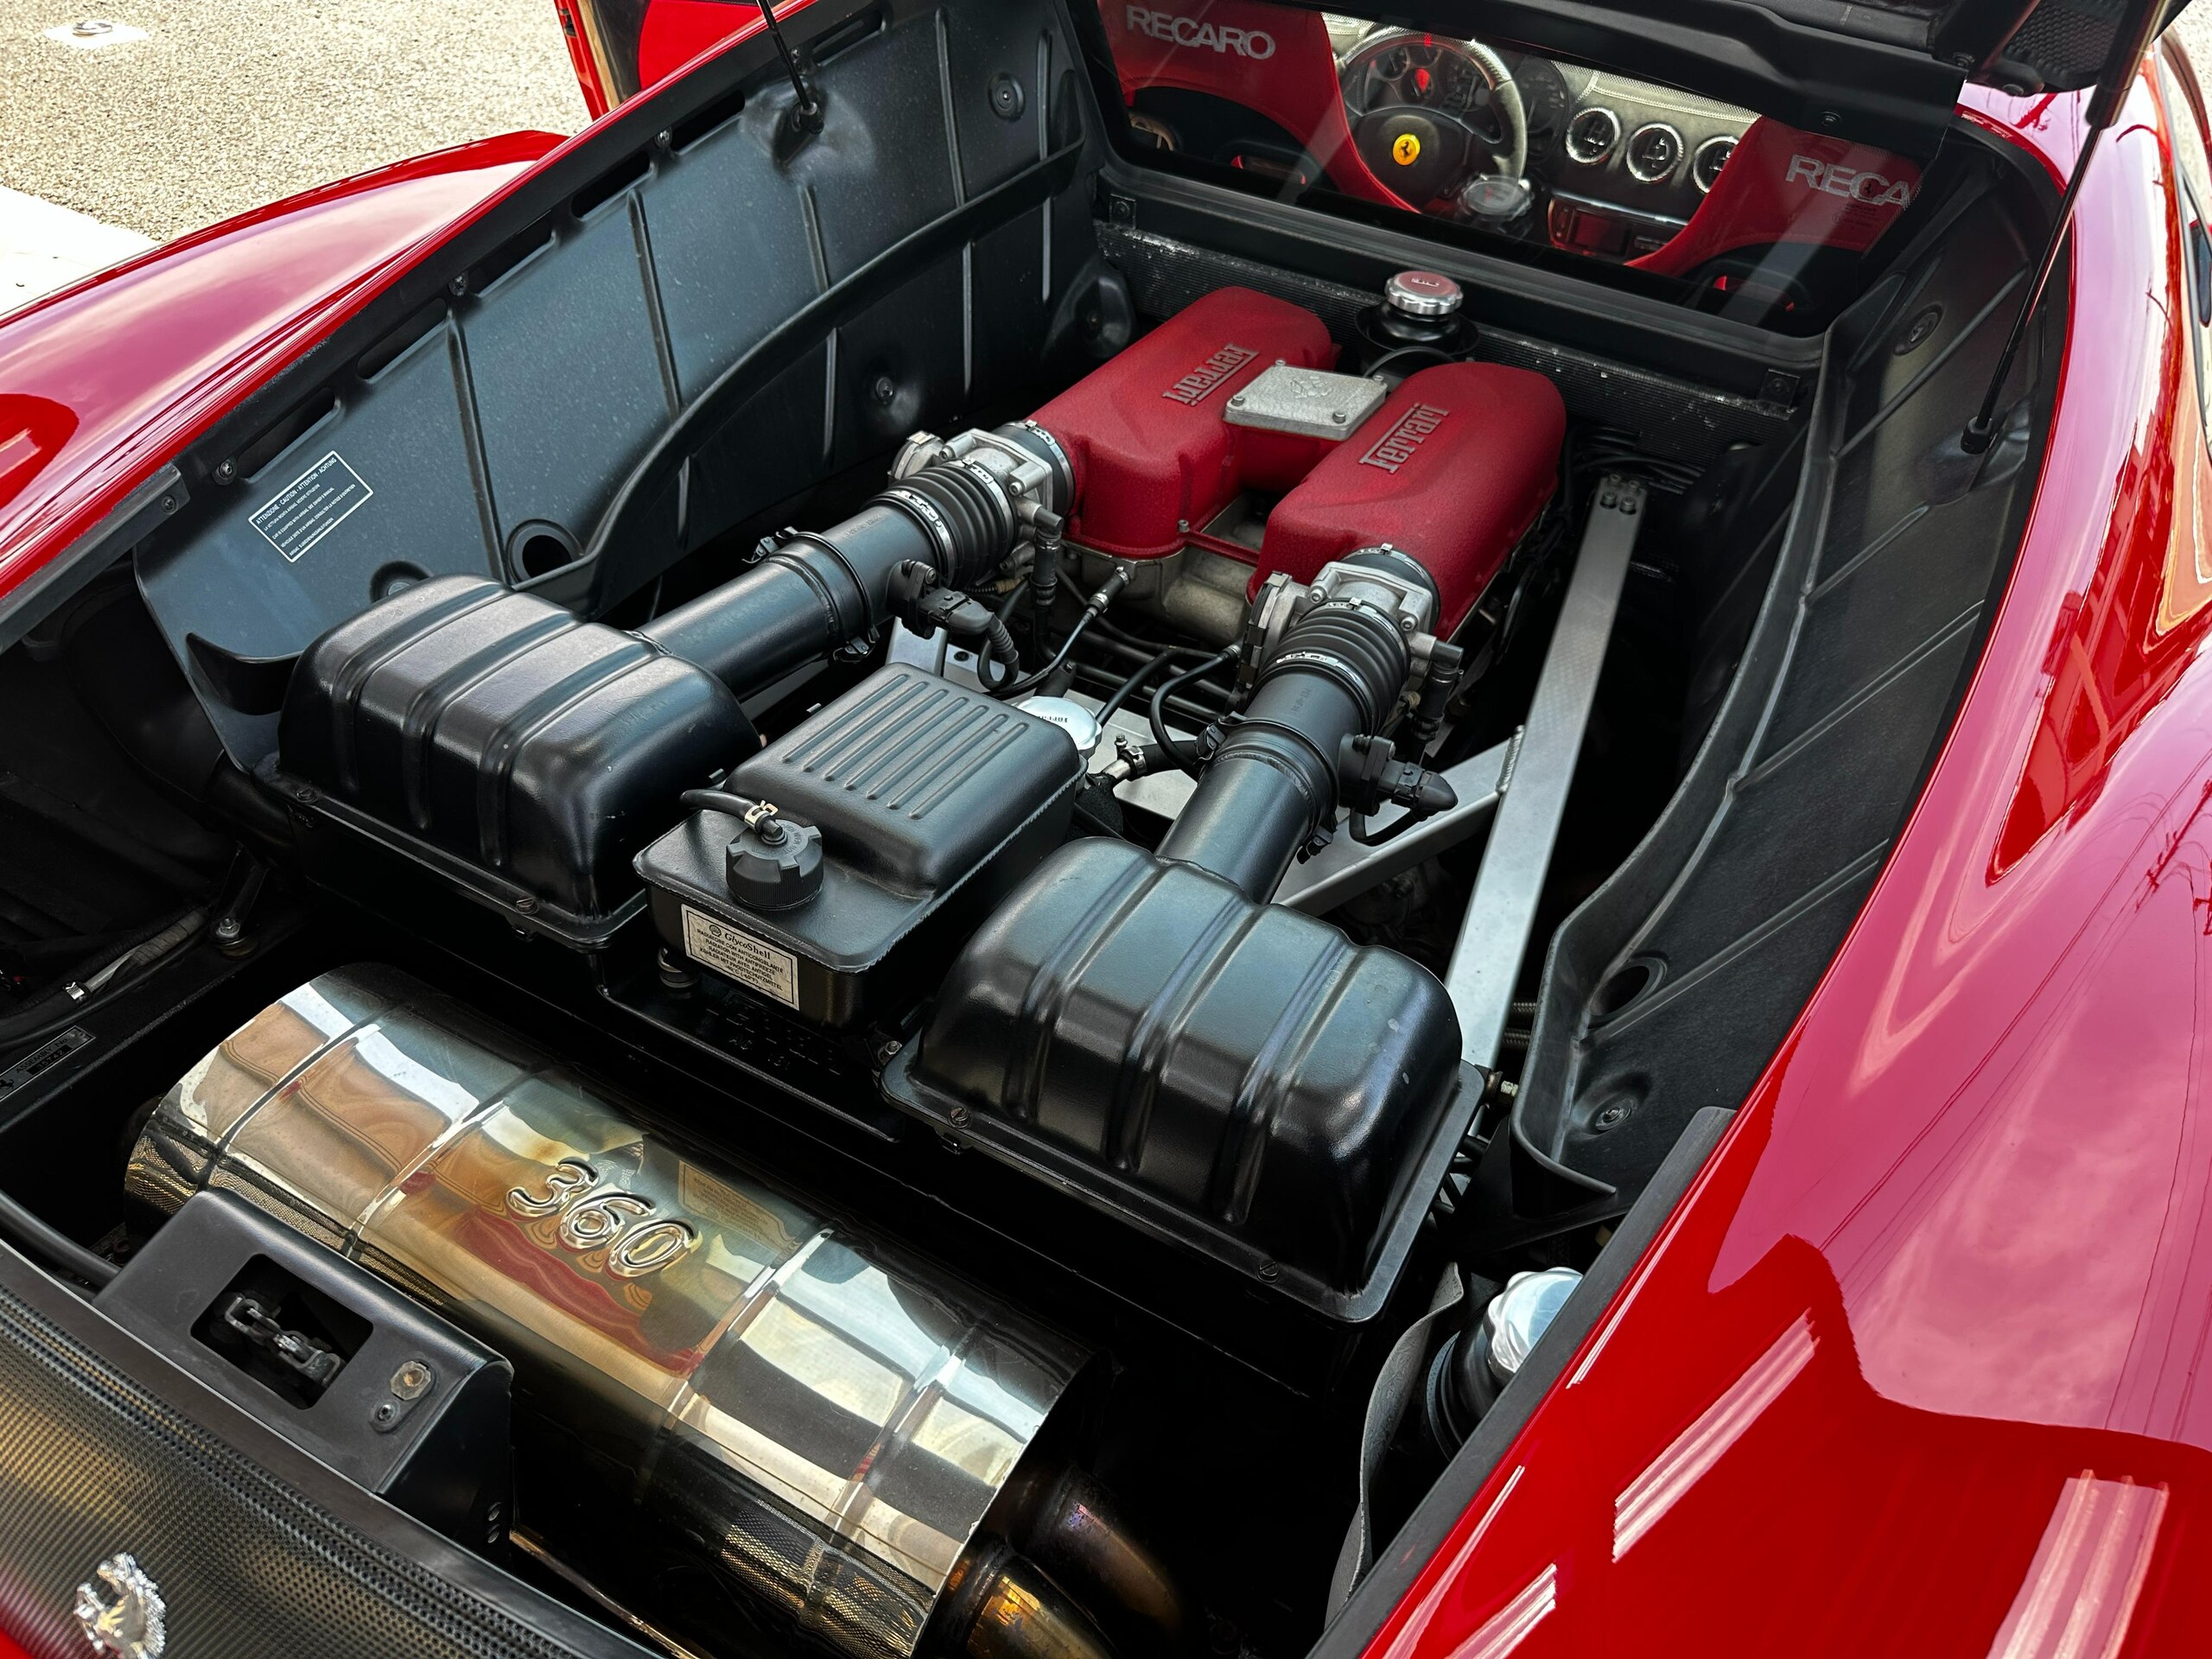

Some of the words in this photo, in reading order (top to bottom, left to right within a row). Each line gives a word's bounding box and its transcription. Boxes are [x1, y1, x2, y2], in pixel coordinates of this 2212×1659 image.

[1127, 4, 1275, 60] RECARO
[1162, 343, 1259, 406] Ferrari
[1358, 402, 1450, 474] Ferrari
[256, 504, 280, 524] ATTENZIONE
[279, 489, 297, 505] CAUTION
[297, 473, 319, 491] ATTENTION
[318, 457, 337, 474] ACHTUNG
[697, 928, 724, 945] RADIATORE
[726, 942, 736, 951] CON
[705, 938, 730, 954] RADIATOR
[731, 950, 743, 960] WITH
[745, 957, 775, 976] ANTIFREEZE
[725, 932, 770, 960] GlycoShell
[752, 966, 772, 981] ANTIGEL
[505, 1156, 699, 1277] 360
